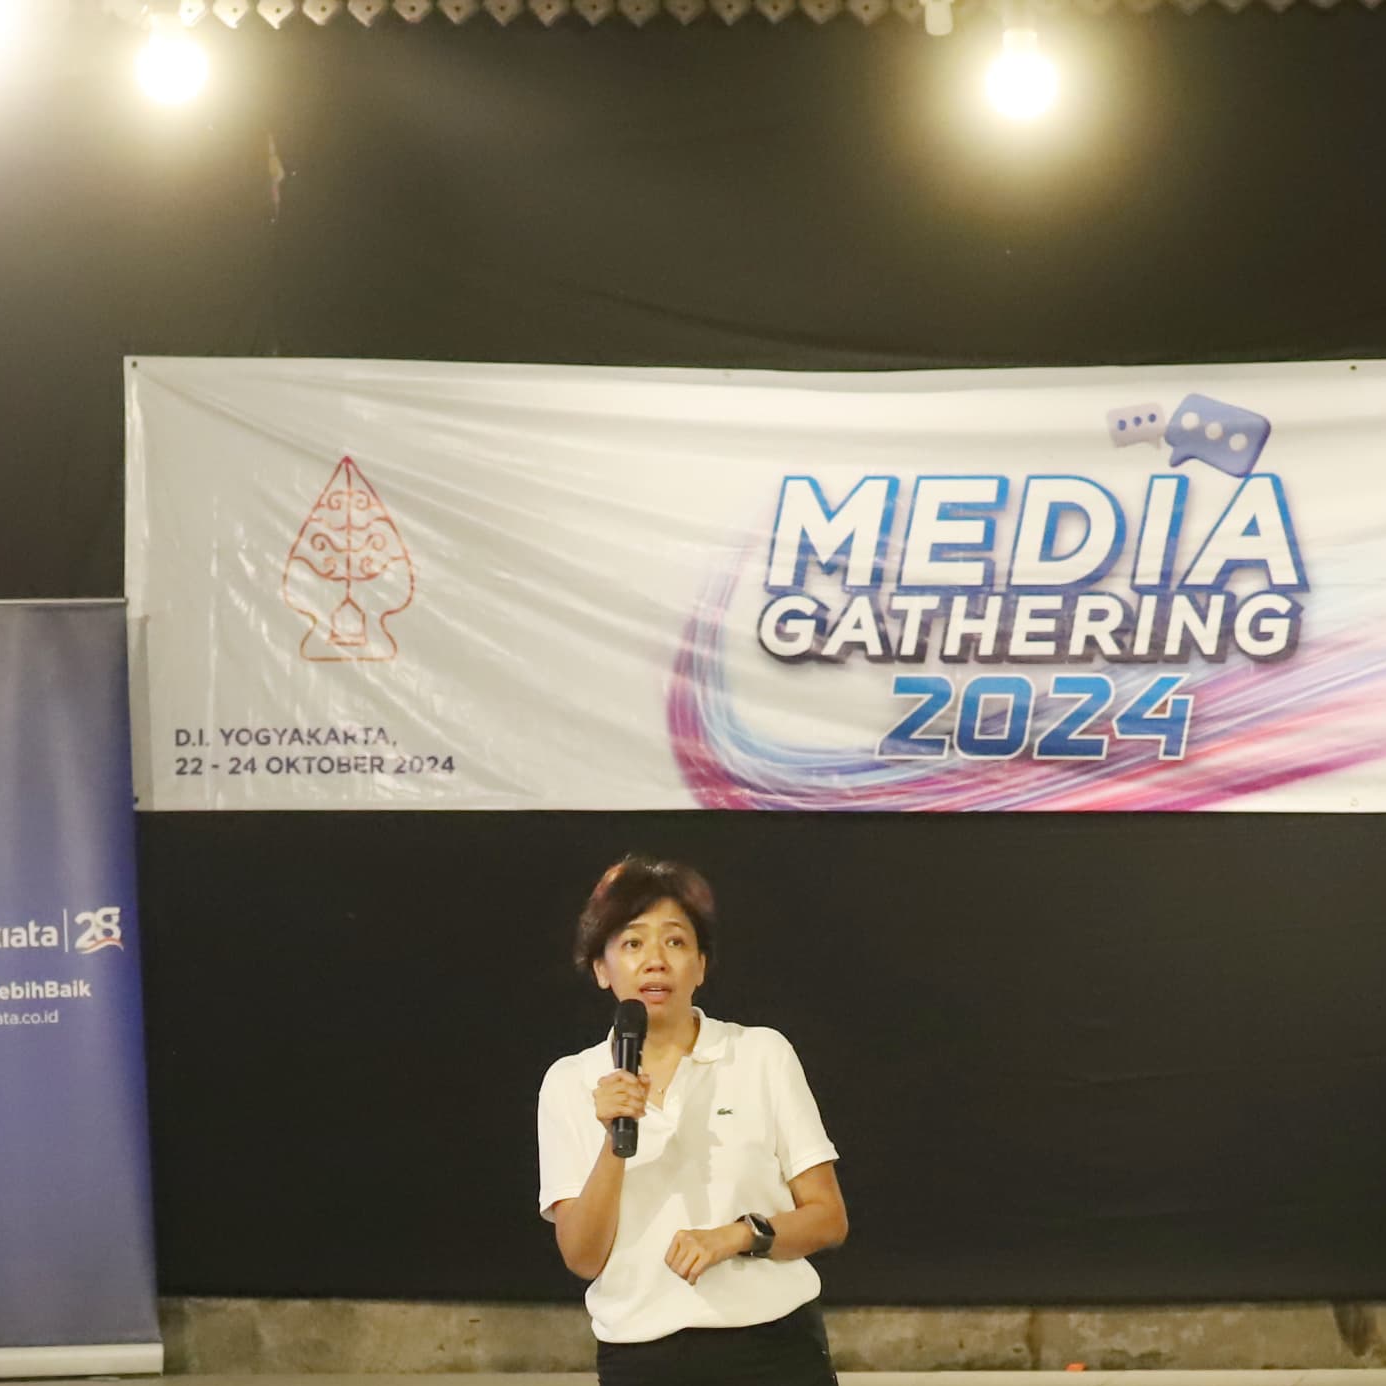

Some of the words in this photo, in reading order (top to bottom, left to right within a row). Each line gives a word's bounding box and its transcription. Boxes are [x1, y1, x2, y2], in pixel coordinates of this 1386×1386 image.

[765, 473, 1309, 594] MEDIA
[758, 592, 1303, 664] GATHERING
[174, 727, 211, 748] D.I.
[219, 726, 398, 749] YOGYAKARTA,
[876, 672, 1195, 761] 2024
[174, 756, 203, 777] 22
[227, 756, 258, 776] 24
[265, 755, 386, 776] OKTOBER
[393, 755, 456, 775] 2024
